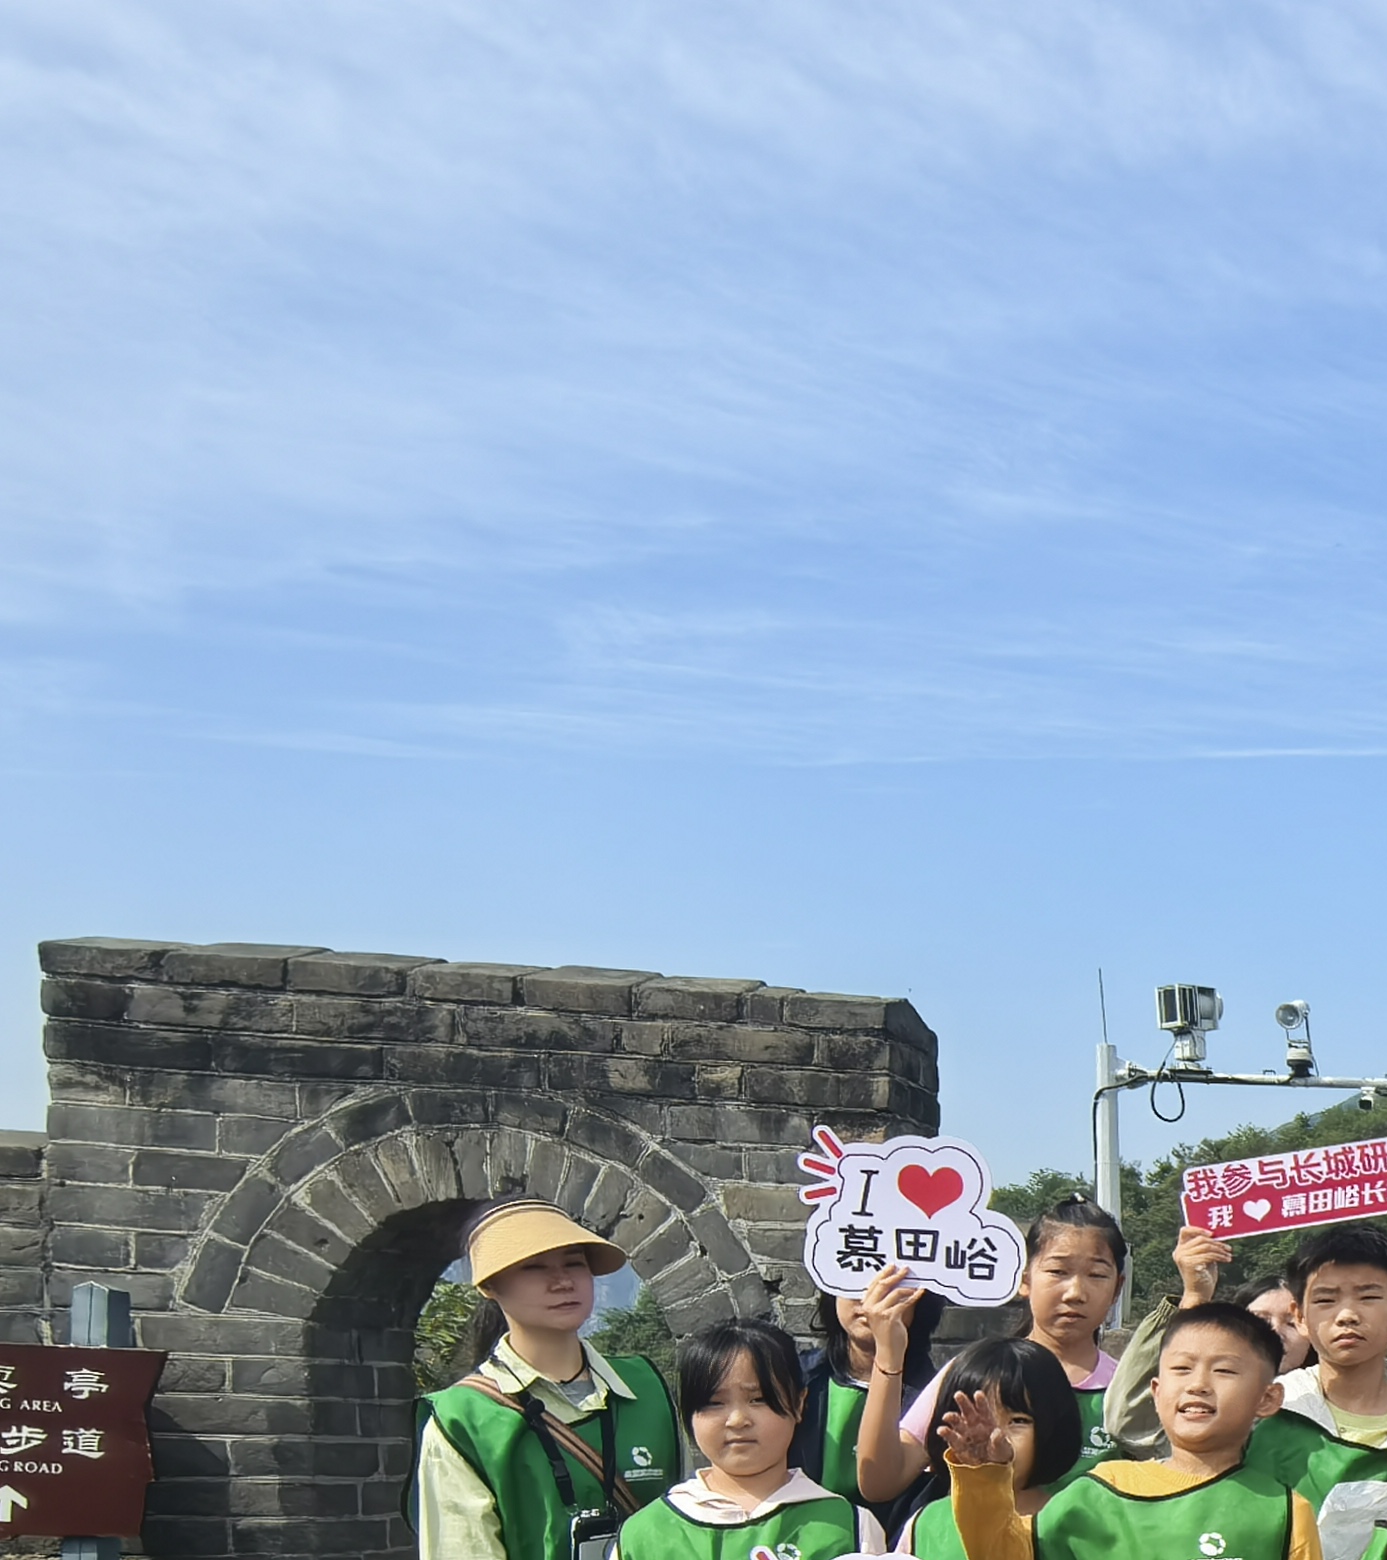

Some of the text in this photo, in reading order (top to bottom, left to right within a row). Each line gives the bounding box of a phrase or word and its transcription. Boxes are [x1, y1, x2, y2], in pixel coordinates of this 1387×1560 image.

[856, 1169, 880, 1217] I
[1208, 1205, 1233, 1229] 我
[836, 1224, 999, 1281] 慕田峪
[20, 1400, 63, 1413] AREA
[13, 1461, 64, 1475] ROAD
